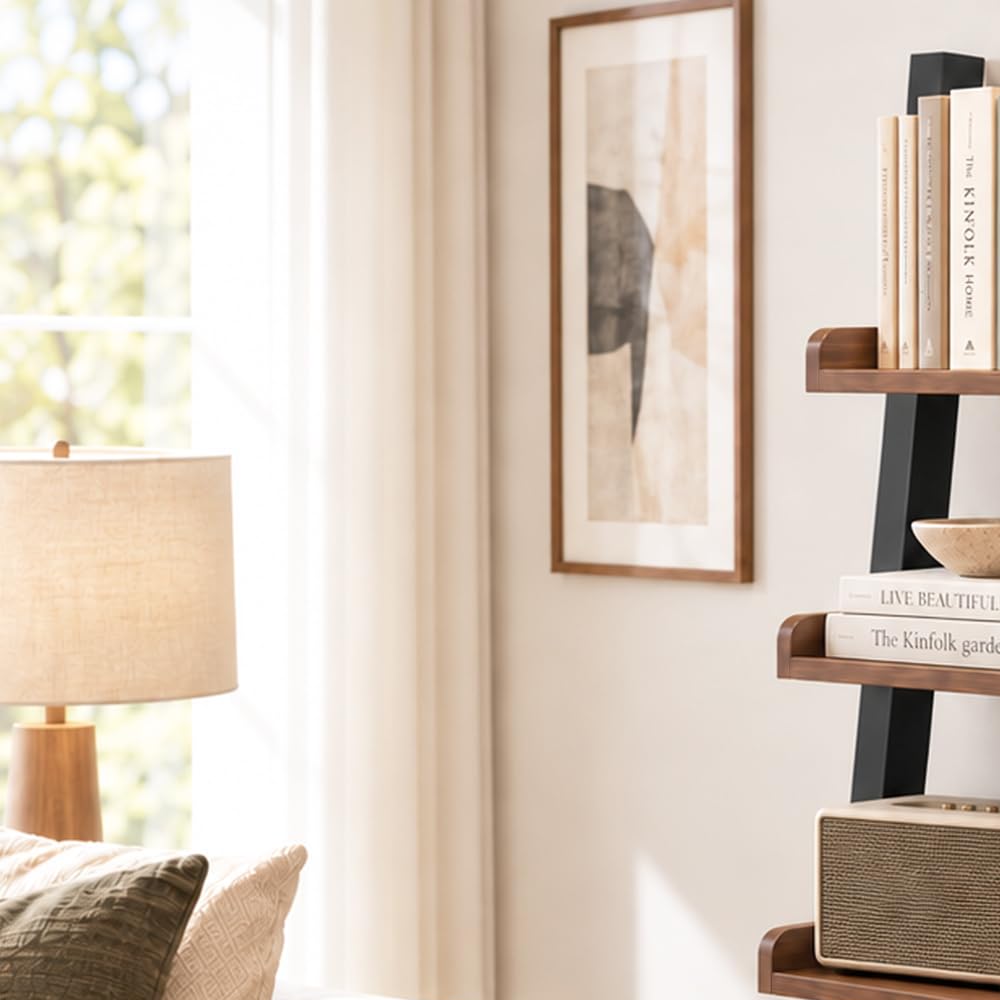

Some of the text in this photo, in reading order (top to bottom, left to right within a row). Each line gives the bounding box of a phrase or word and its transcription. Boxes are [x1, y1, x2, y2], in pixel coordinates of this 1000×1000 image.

[880, 589, 914, 606] LIVE
[871, 628, 899, 648] The
[903, 630, 957, 652] Kinfolk
